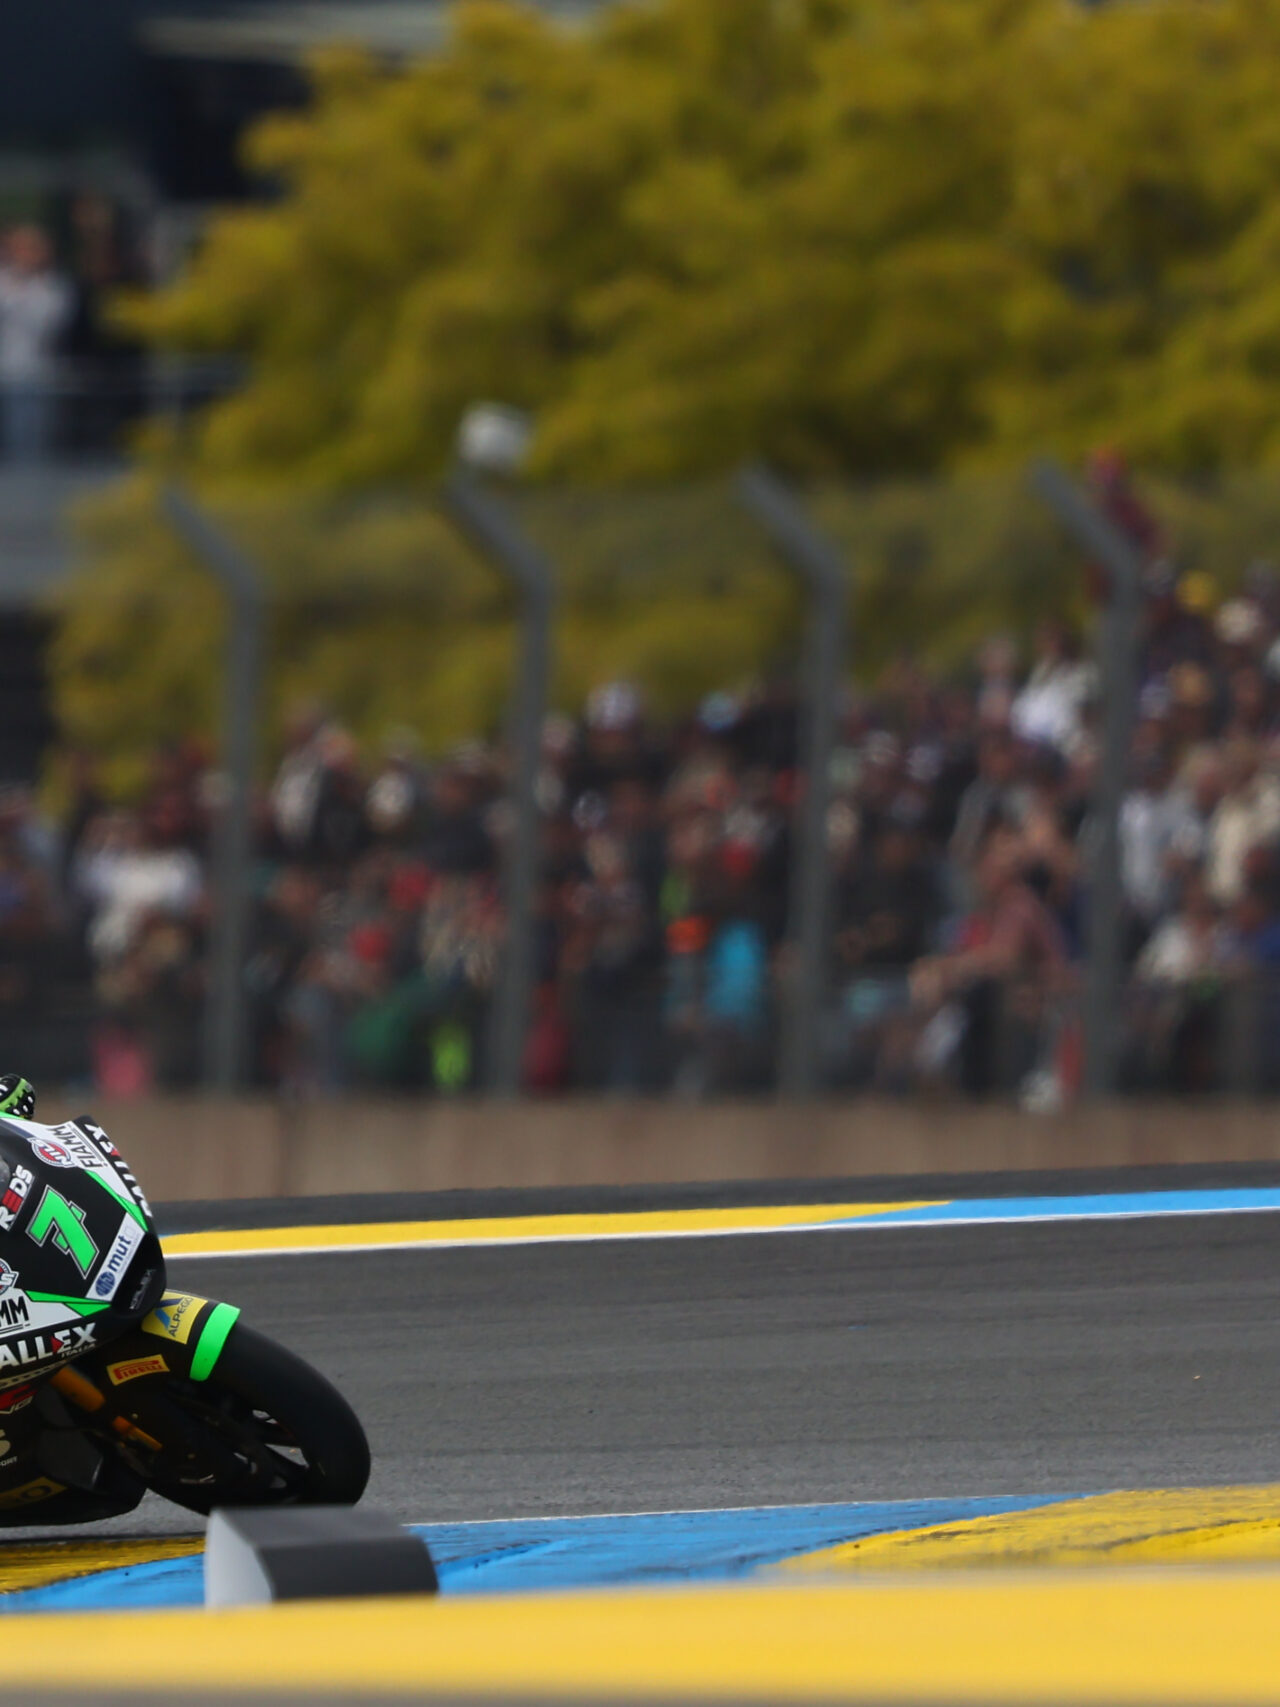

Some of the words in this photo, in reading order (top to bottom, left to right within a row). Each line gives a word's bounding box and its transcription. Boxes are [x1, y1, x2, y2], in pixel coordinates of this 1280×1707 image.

[25, 1184, 100, 1280] 7
[107, 1235, 132, 1272] mut
[168, 1296, 193, 1337] ALPEGO
